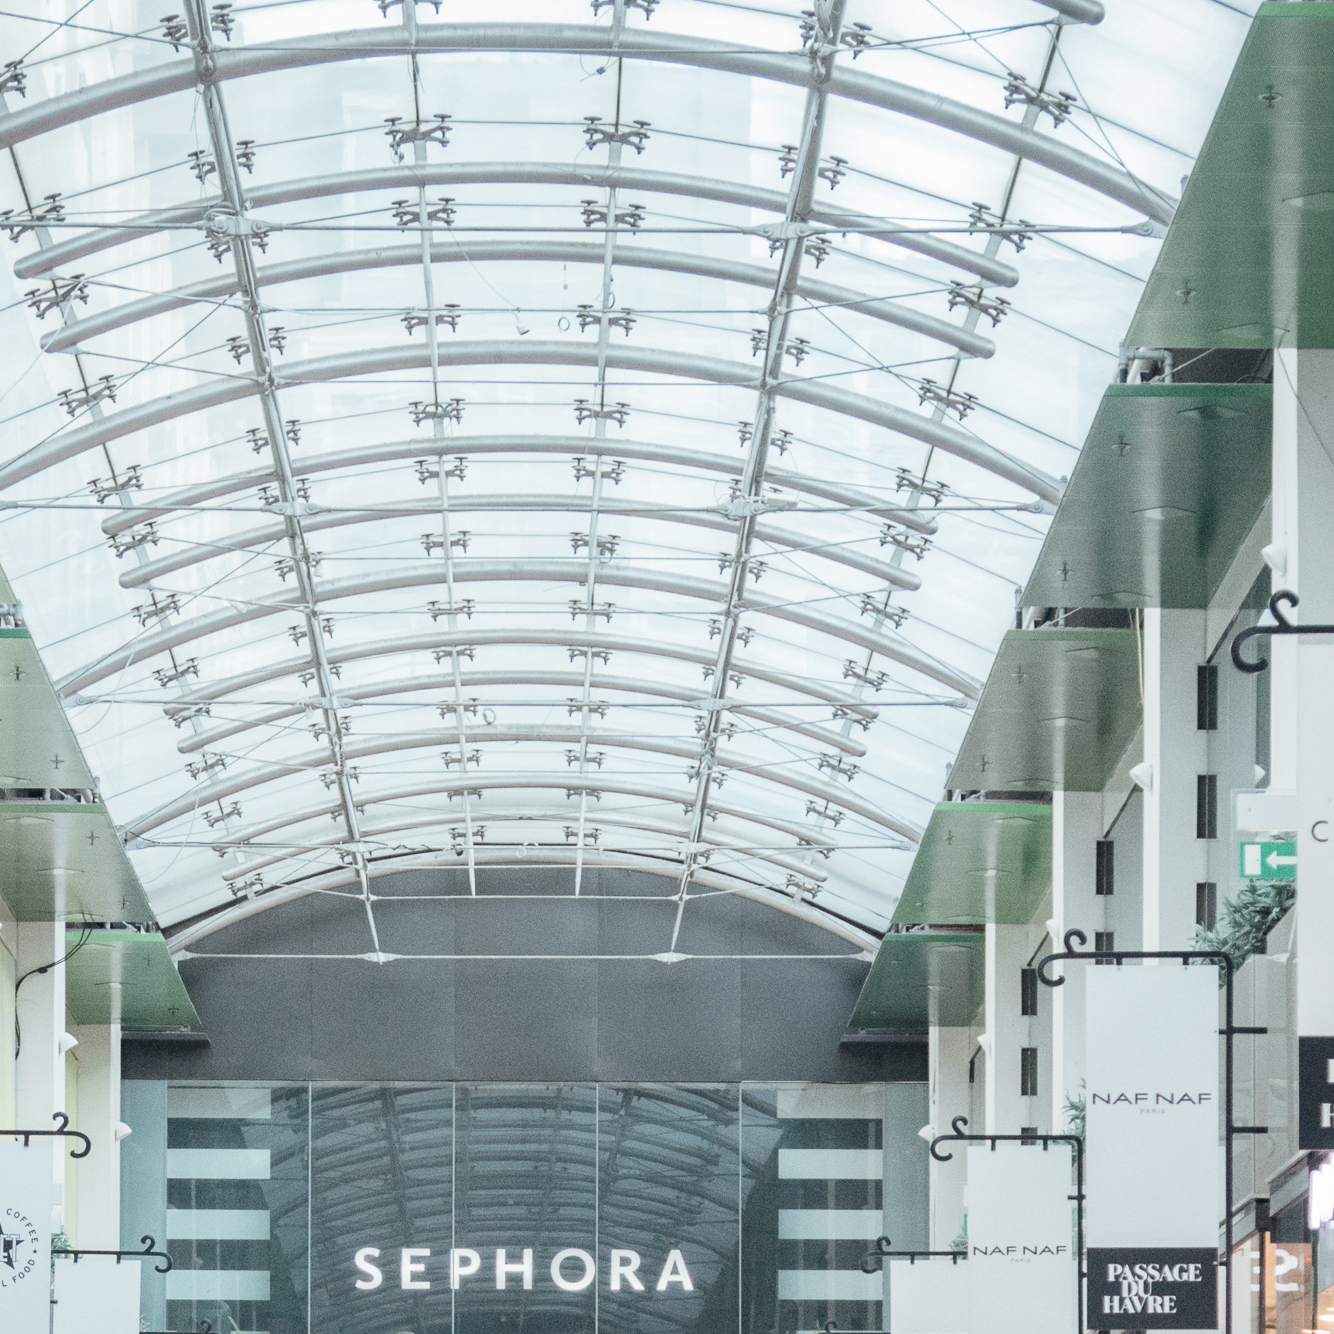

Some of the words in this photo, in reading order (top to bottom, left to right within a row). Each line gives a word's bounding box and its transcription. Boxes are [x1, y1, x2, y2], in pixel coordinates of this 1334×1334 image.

[1093, 1092, 1148, 1105] NAF
[1156, 1092, 1212, 1105] NAF
[6, 1207, 39, 1244] COFFEE
[973, 1245, 1017, 1255] NAF
[1023, 1245, 1067, 1255] NAF
[12, 1258, 36, 1284] FOOD
[355, 1246, 695, 1292] SEPHORA
[1108, 1264, 1201, 1283] PASSAGE
[1122, 1280, 1151, 1298] DU
[1104, 1295, 1176, 1313] HAVRE
